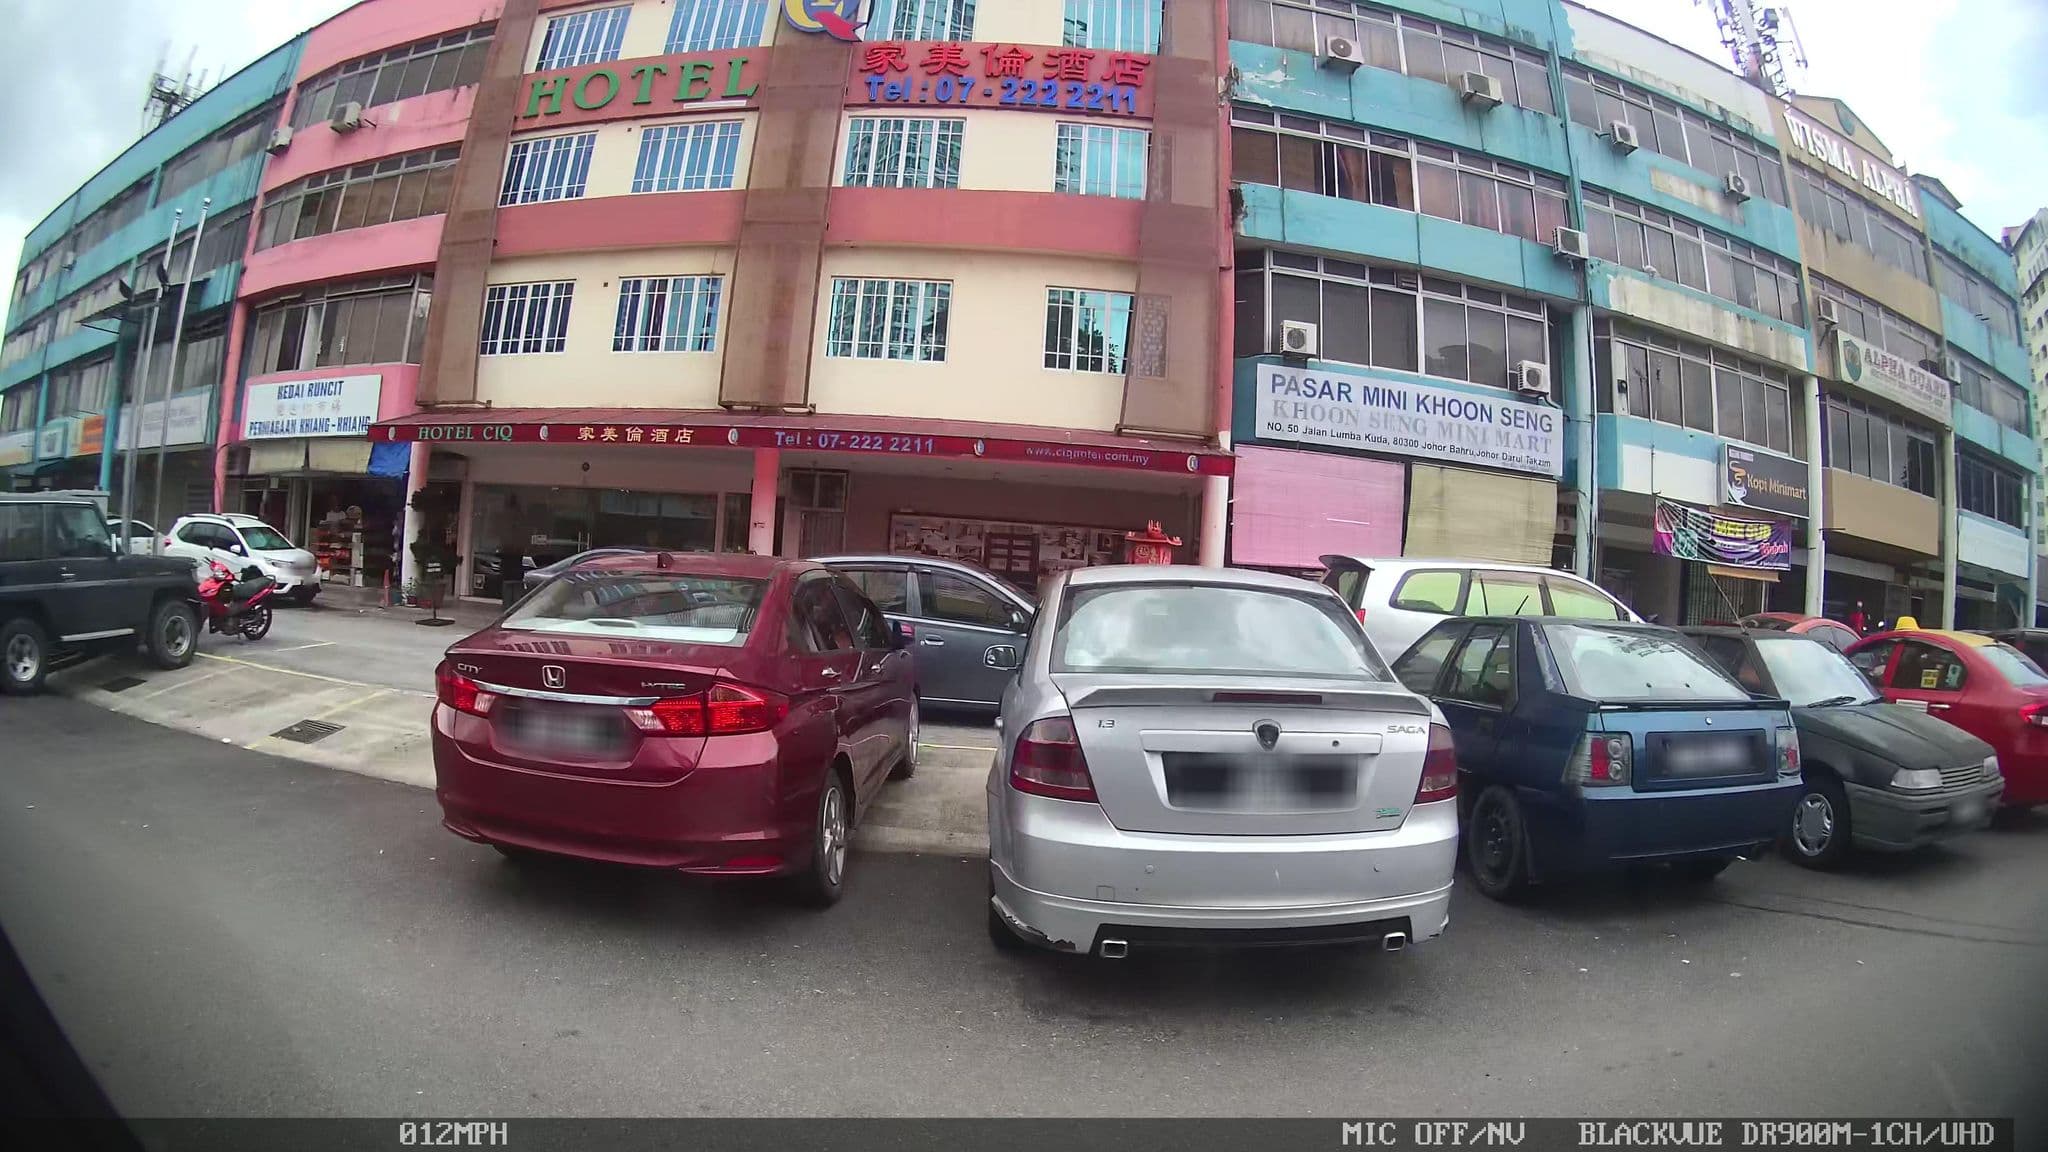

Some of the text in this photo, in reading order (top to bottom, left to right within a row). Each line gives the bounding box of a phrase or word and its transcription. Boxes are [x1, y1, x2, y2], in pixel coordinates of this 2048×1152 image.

[859, 43, 1150, 87] 家美倫酒店
[522, 56, 759, 118] HOTEL
[1066, 82, 1136, 114] 2211
[1782, 112, 1918, 219] WISMA ALPHA
[277, 380, 344, 400] KEDAI RUNCIT
[1271, 373, 1553, 434] PASAR MINI KHOON SENG
[418, 425, 513, 441] HOTEL CIQ
[577, 427, 695, 443] 家美倫酒店
[1272, 399, 1552, 454] KHOON SENG MINI MART
[888, 437, 934, 453] 2211
[1267, 422, 1285, 432] NO.
[1287, 424, 1299, 434] 50
[1302, 426, 1327, 438] Jalan
[1330, 429, 1361, 441] Lumba
[1364, 433, 1390, 446] Kuda,
[1392, 437, 1419, 448] 80300
[1422, 441, 1446, 452] Johor
[1502, 452, 1523, 462] Darul
[1526, 455, 1551, 467] Takzim
[1747, 473, 1807, 500] Kopi Minimart
[1098, 719, 1116, 728] 1.3
[1386, 725, 1426, 735] SAGA
